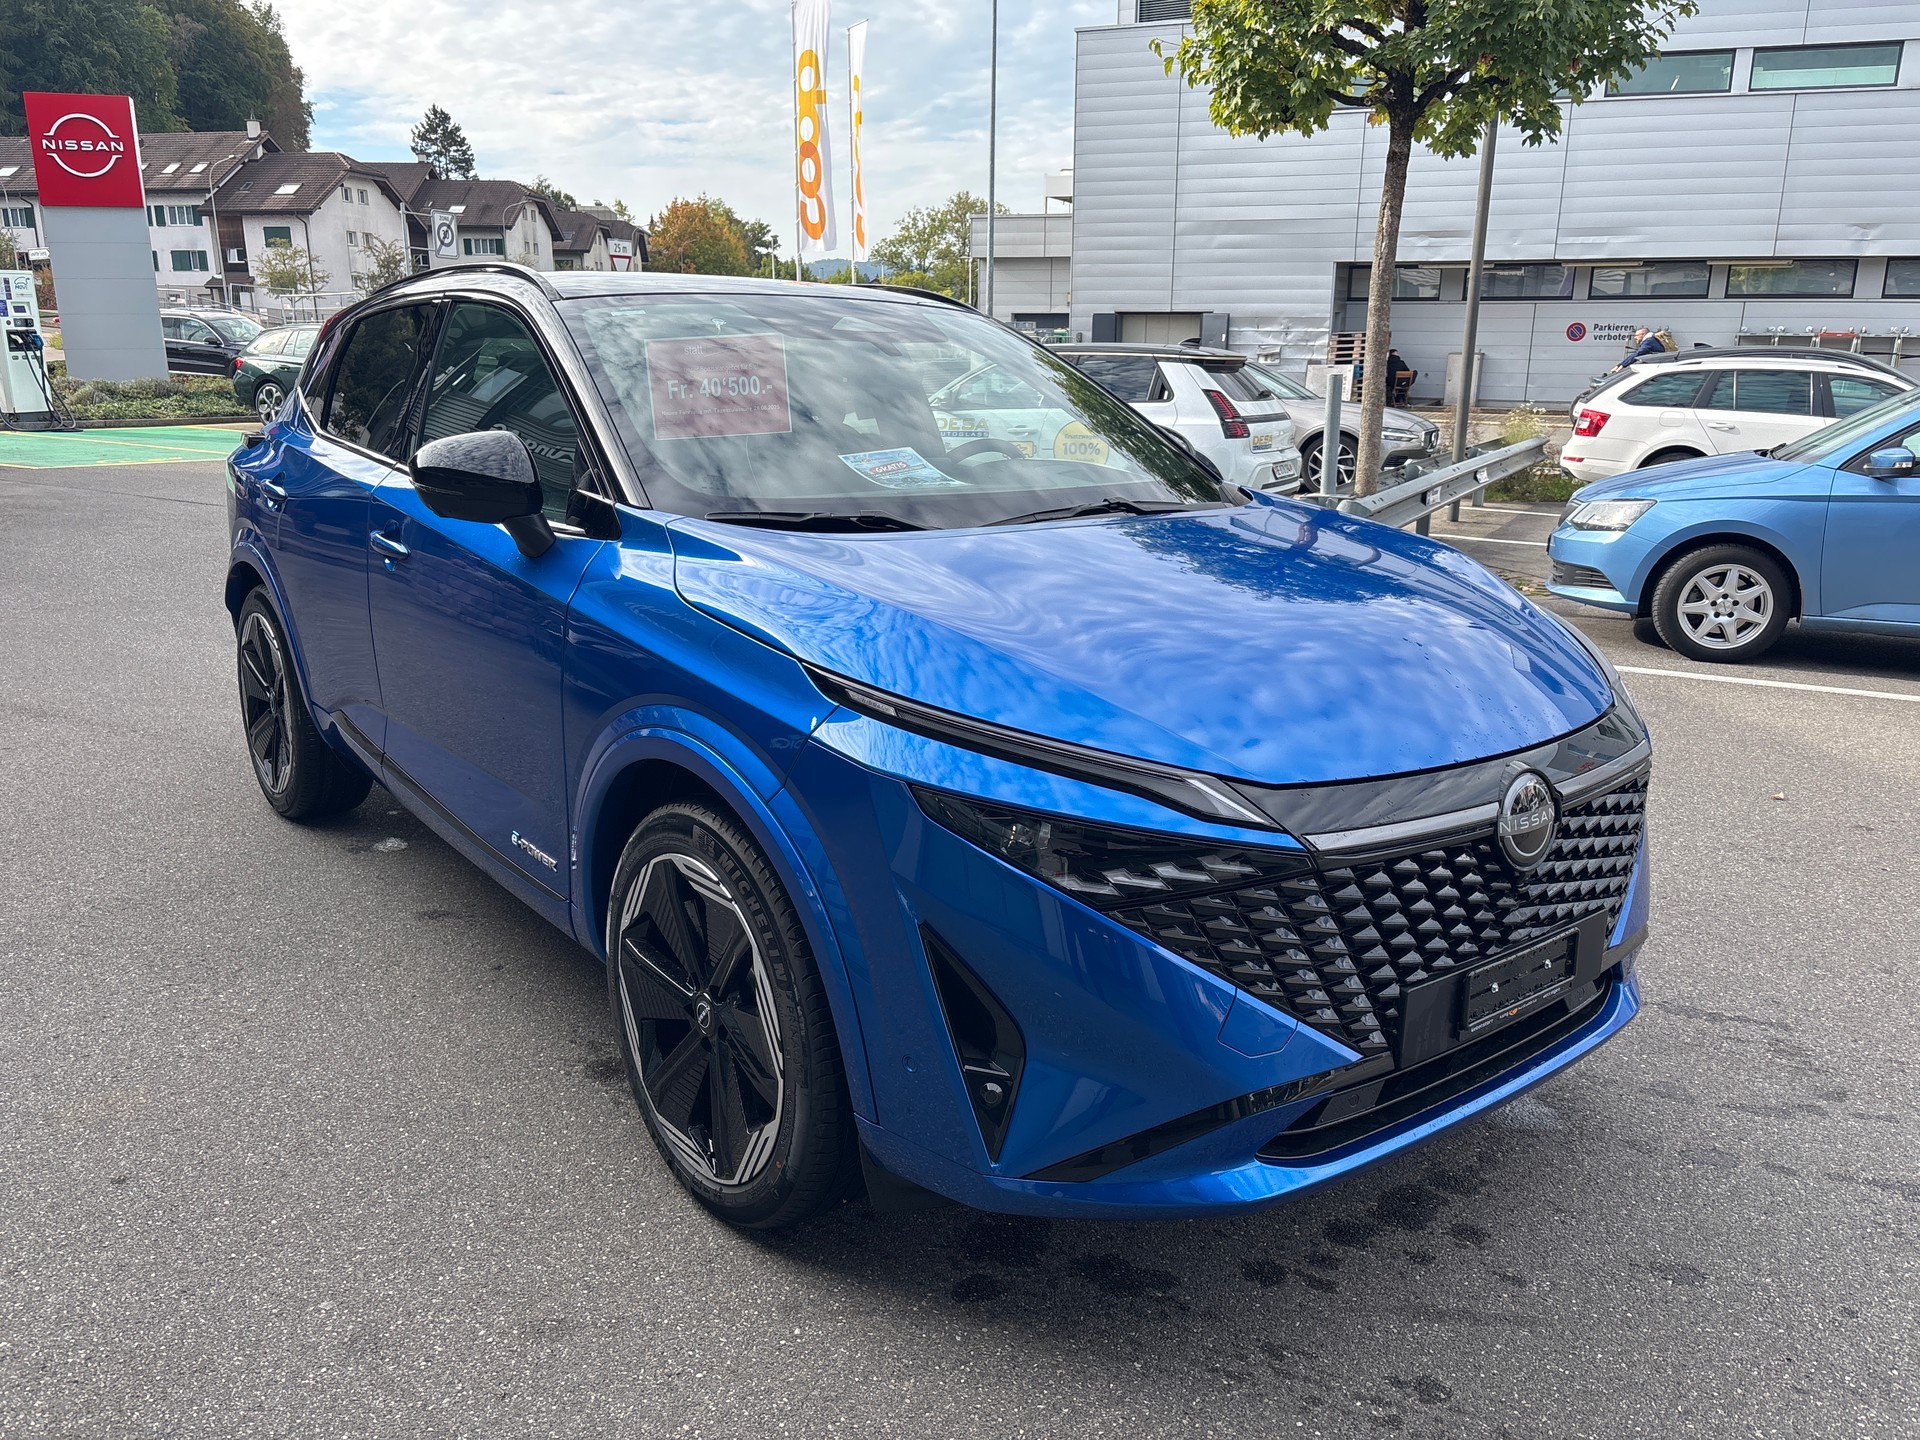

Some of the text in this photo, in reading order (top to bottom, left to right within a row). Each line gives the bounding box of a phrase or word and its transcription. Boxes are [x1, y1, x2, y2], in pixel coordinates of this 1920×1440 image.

[41, 138, 124, 152] NISSAN
[797, 48, 827, 241] coop
[441, 229, 450, 240] 30
[613, 243, 621, 252] 25
[1593, 323, 1634, 331] Parkieren
[684, 345, 704, 356] statt
[667, 379, 694, 399] Fr.
[937, 416, 989, 430] DESA
[1062, 442, 1101, 456] 100%
[875, 461, 907, 473] GRATIS
[1499, 807, 1555, 834] NISSAN
[718, 852, 788, 982] MICHELIN
